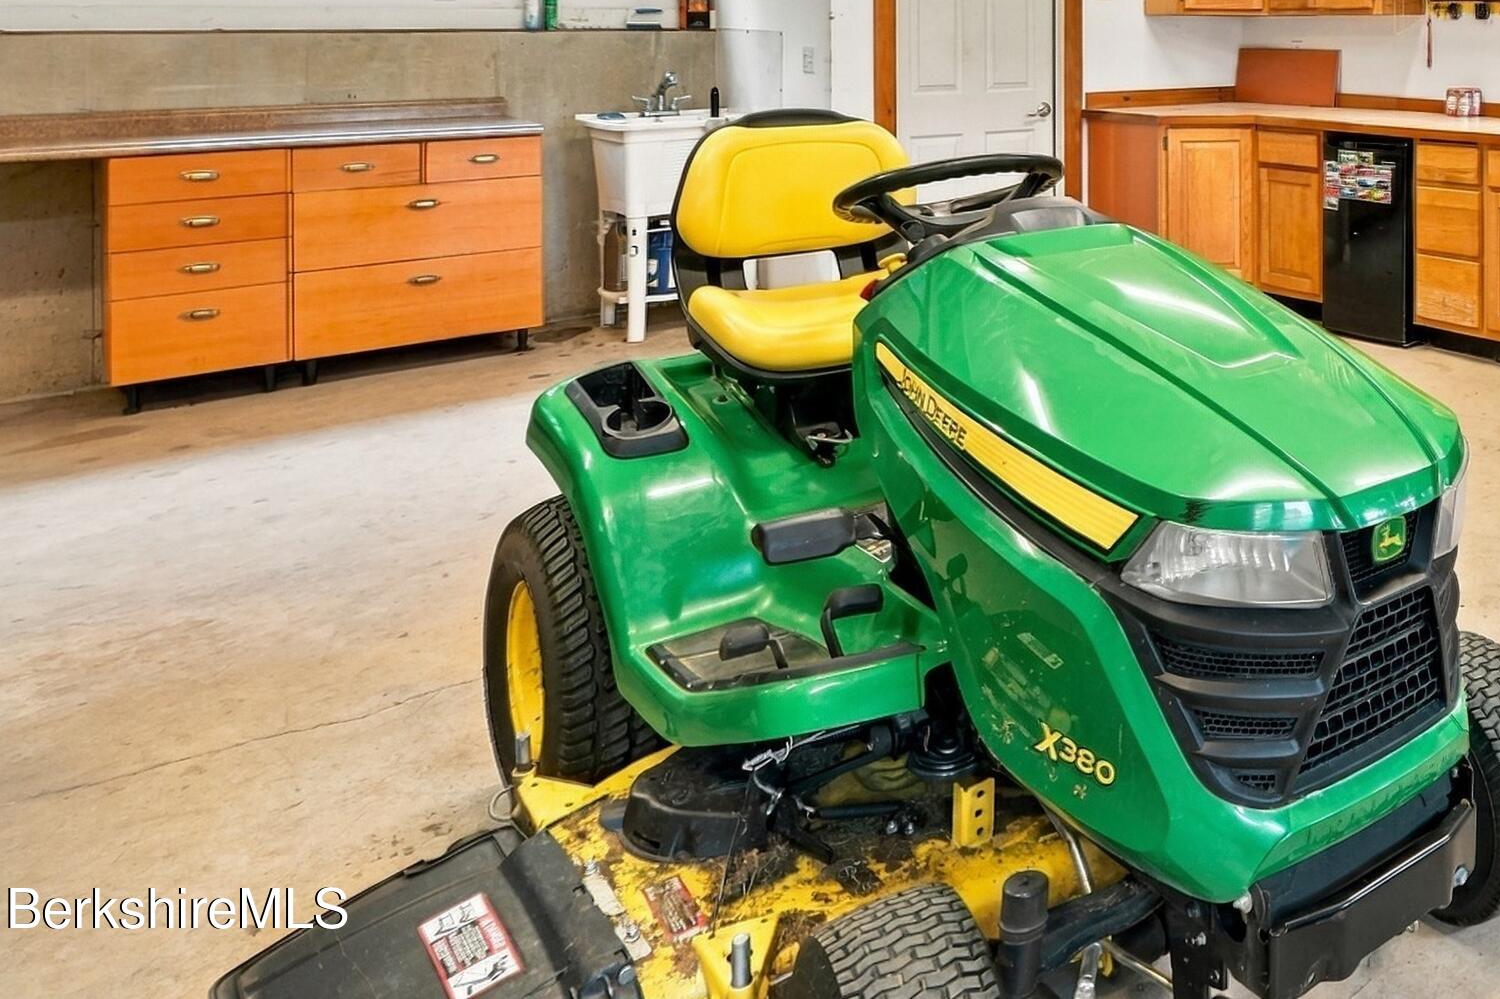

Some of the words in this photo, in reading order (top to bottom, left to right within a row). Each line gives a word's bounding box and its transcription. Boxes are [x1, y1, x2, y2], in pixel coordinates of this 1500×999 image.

[896, 368, 926, 409] JOHN
[924, 394, 967, 447] DEERE
[1034, 720, 1116, 786] X380
